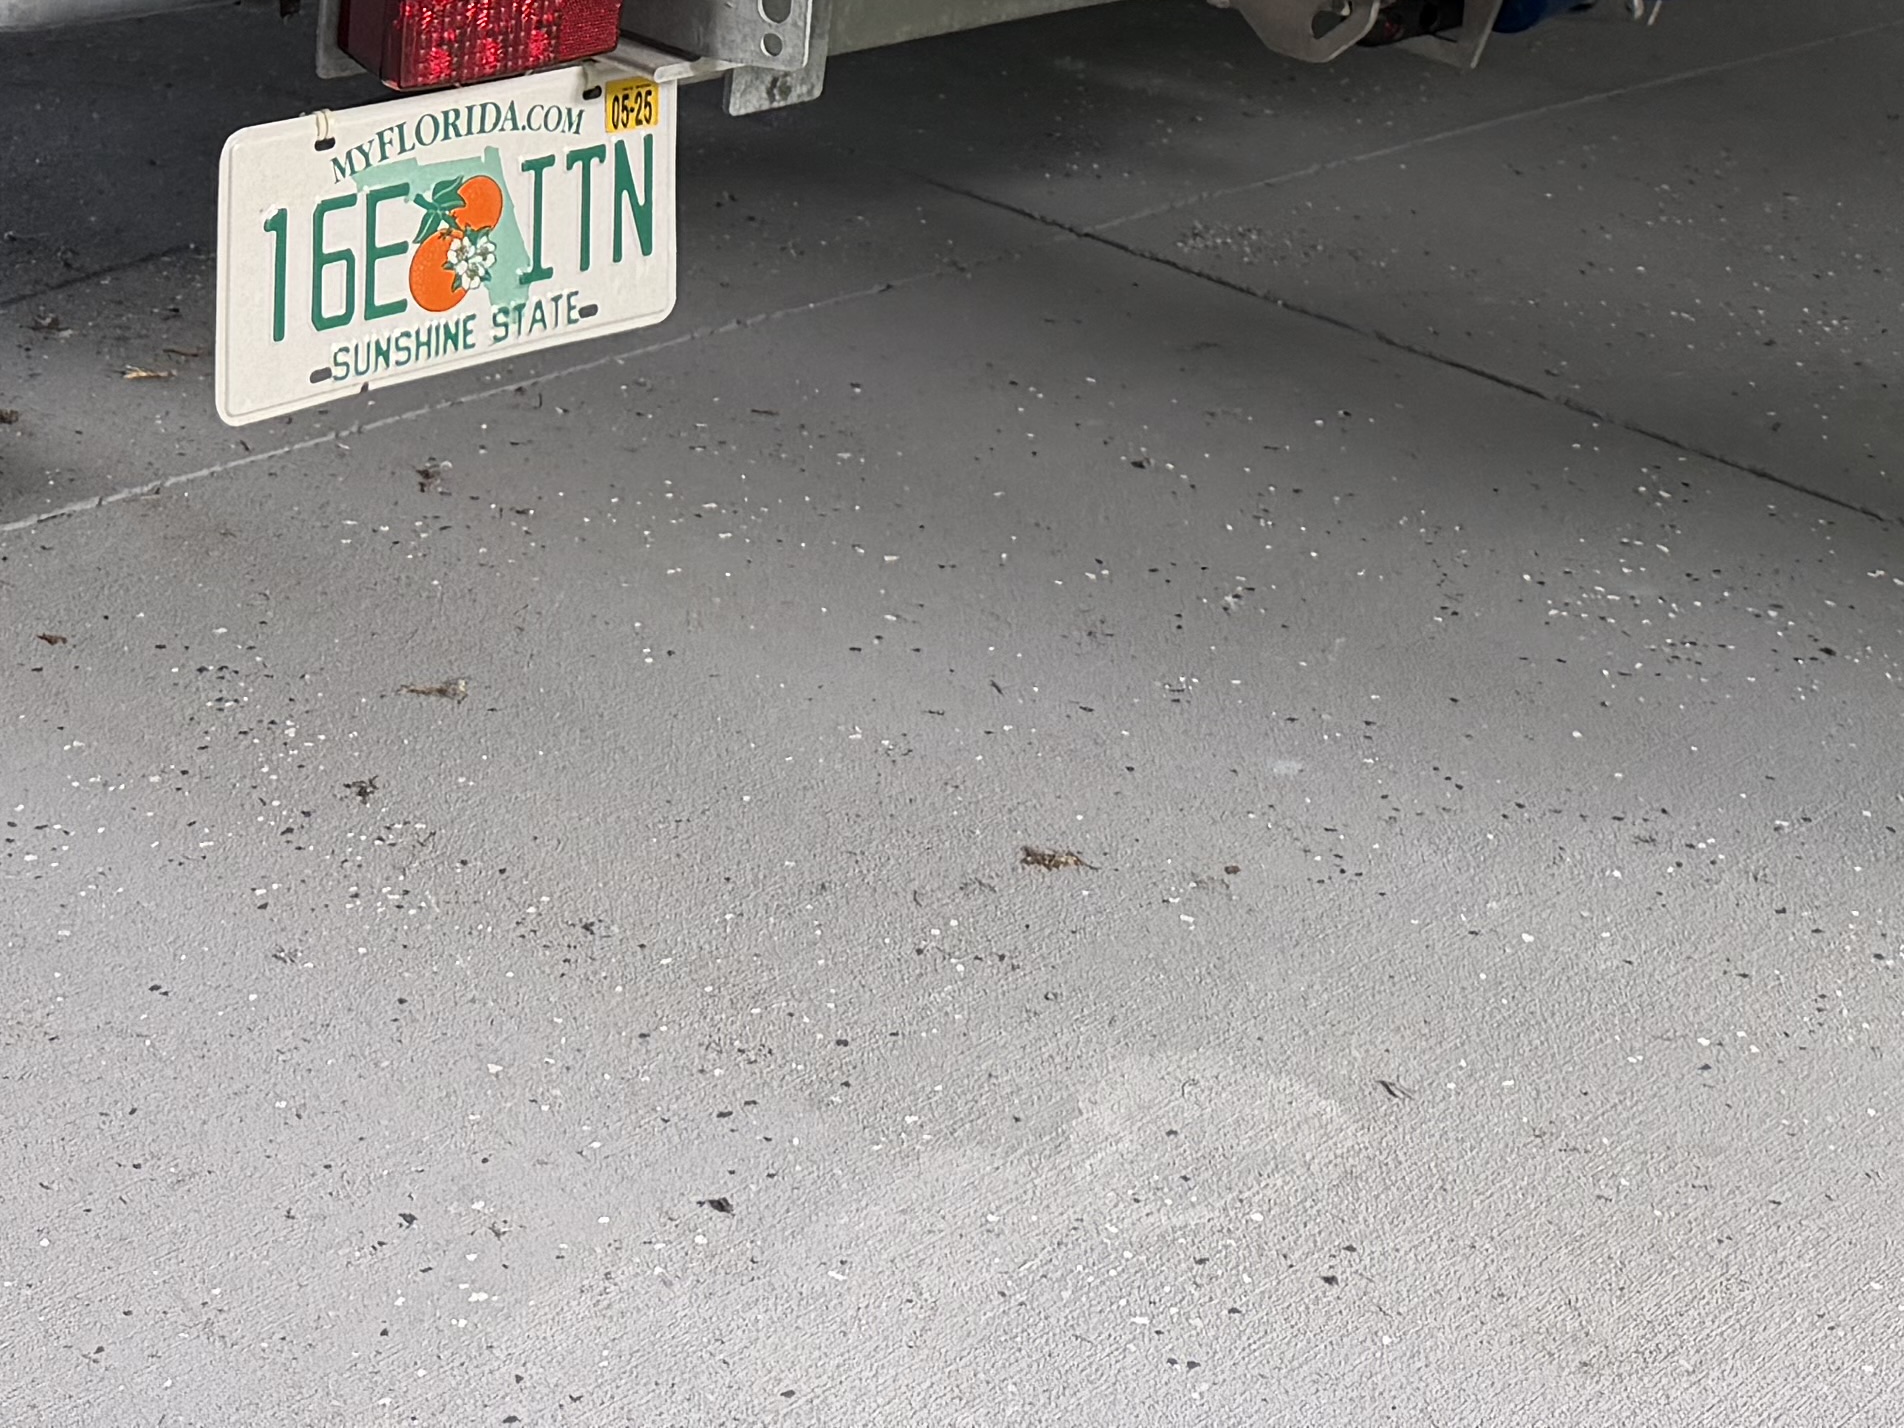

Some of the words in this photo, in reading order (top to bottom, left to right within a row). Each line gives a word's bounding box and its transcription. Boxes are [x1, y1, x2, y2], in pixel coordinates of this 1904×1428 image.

[329, 99, 585, 186] MYFLORIDA.COM
[612, 89, 653, 130] 05-25
[263, 181, 410, 344] 16E
[517, 132, 654, 287] ITN
[330, 311, 478, 384] SUNSHINE
[490, 288, 582, 348] STATE
